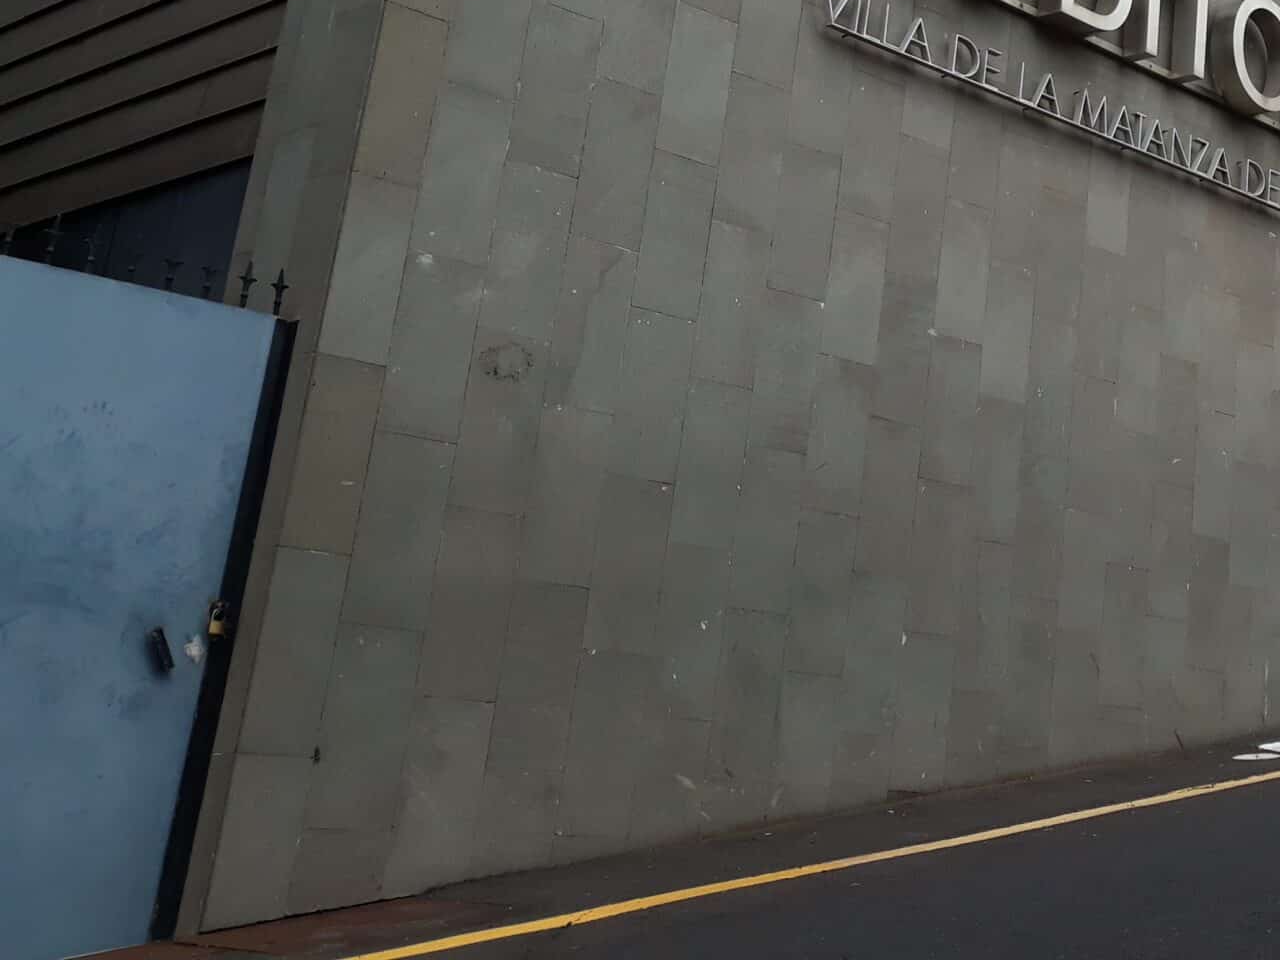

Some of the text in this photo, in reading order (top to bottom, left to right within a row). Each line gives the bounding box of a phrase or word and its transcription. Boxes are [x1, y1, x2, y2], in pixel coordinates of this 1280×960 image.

[952, 33, 1002, 91] DE
[1019, 61, 1061, 117] LA
[1077, 87, 1232, 187] MATANZA
[1244, 158, 1280, 208] DE
